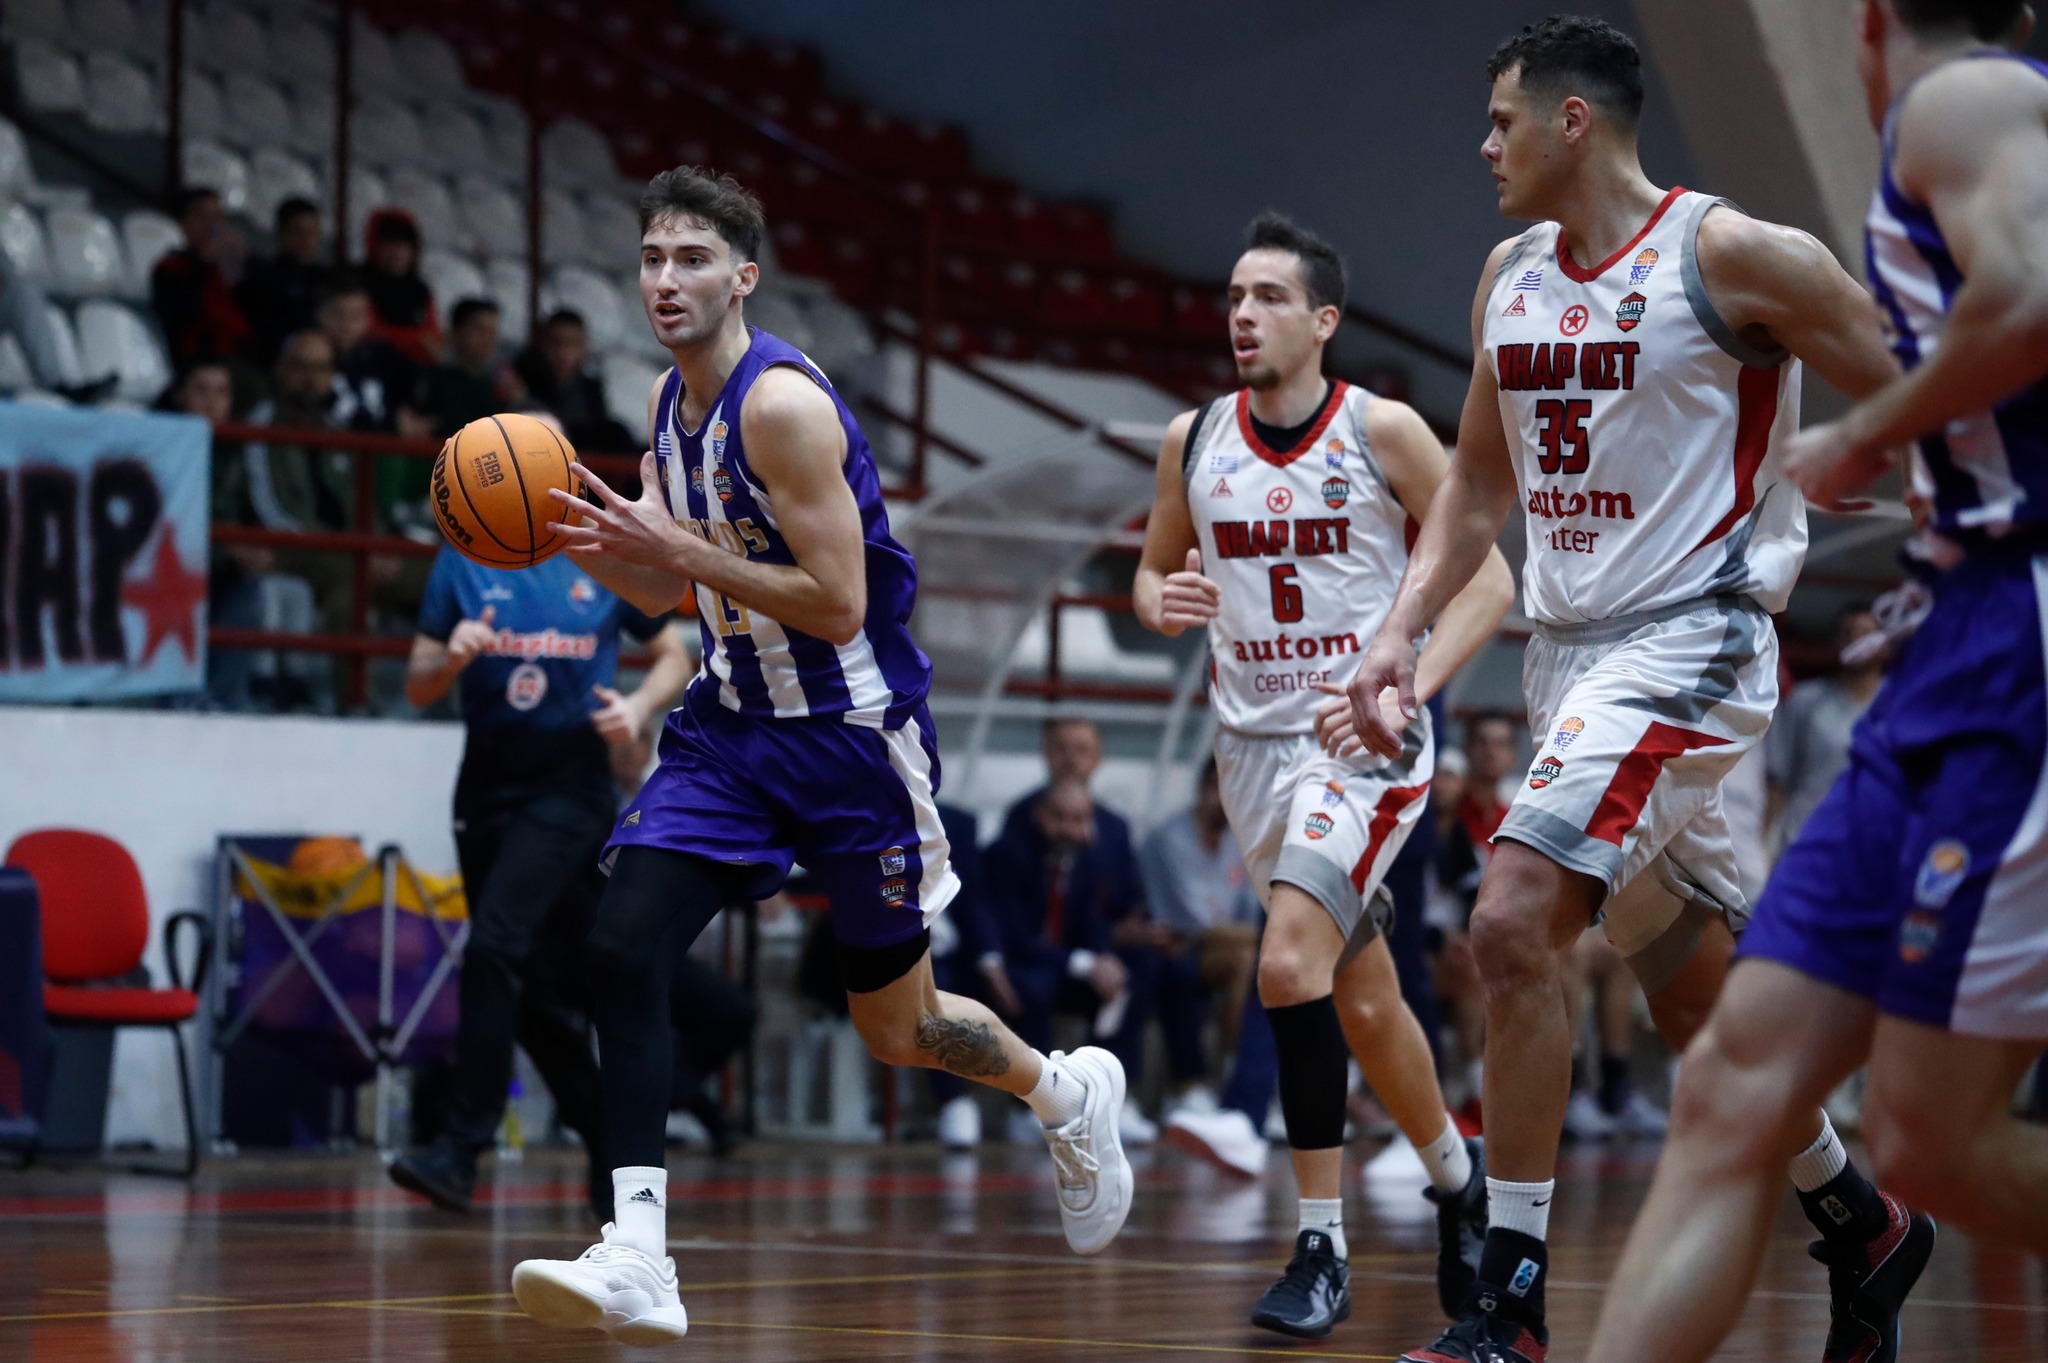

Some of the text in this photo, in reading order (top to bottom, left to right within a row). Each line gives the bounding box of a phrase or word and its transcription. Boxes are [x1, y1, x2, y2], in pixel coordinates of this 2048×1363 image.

[1618, 300, 1644, 312] ELITE
[1535, 399, 1592, 475] 35
[474, 457, 489, 488] APPROVED
[481, 451, 504, 485] FIBA
[714, 476, 733, 485] ELITE
[433, 446, 474, 547] Wilson
[1322, 482, 1350, 495] ELITE
[1528, 485, 1635, 520] autom
[1269, 562, 1304, 624] 6
[1233, 632, 1361, 663] autom
[1254, 669, 1332, 693] center
[882, 884, 906, 896] ELITE
[630, 1196, 658, 1204] adidas
